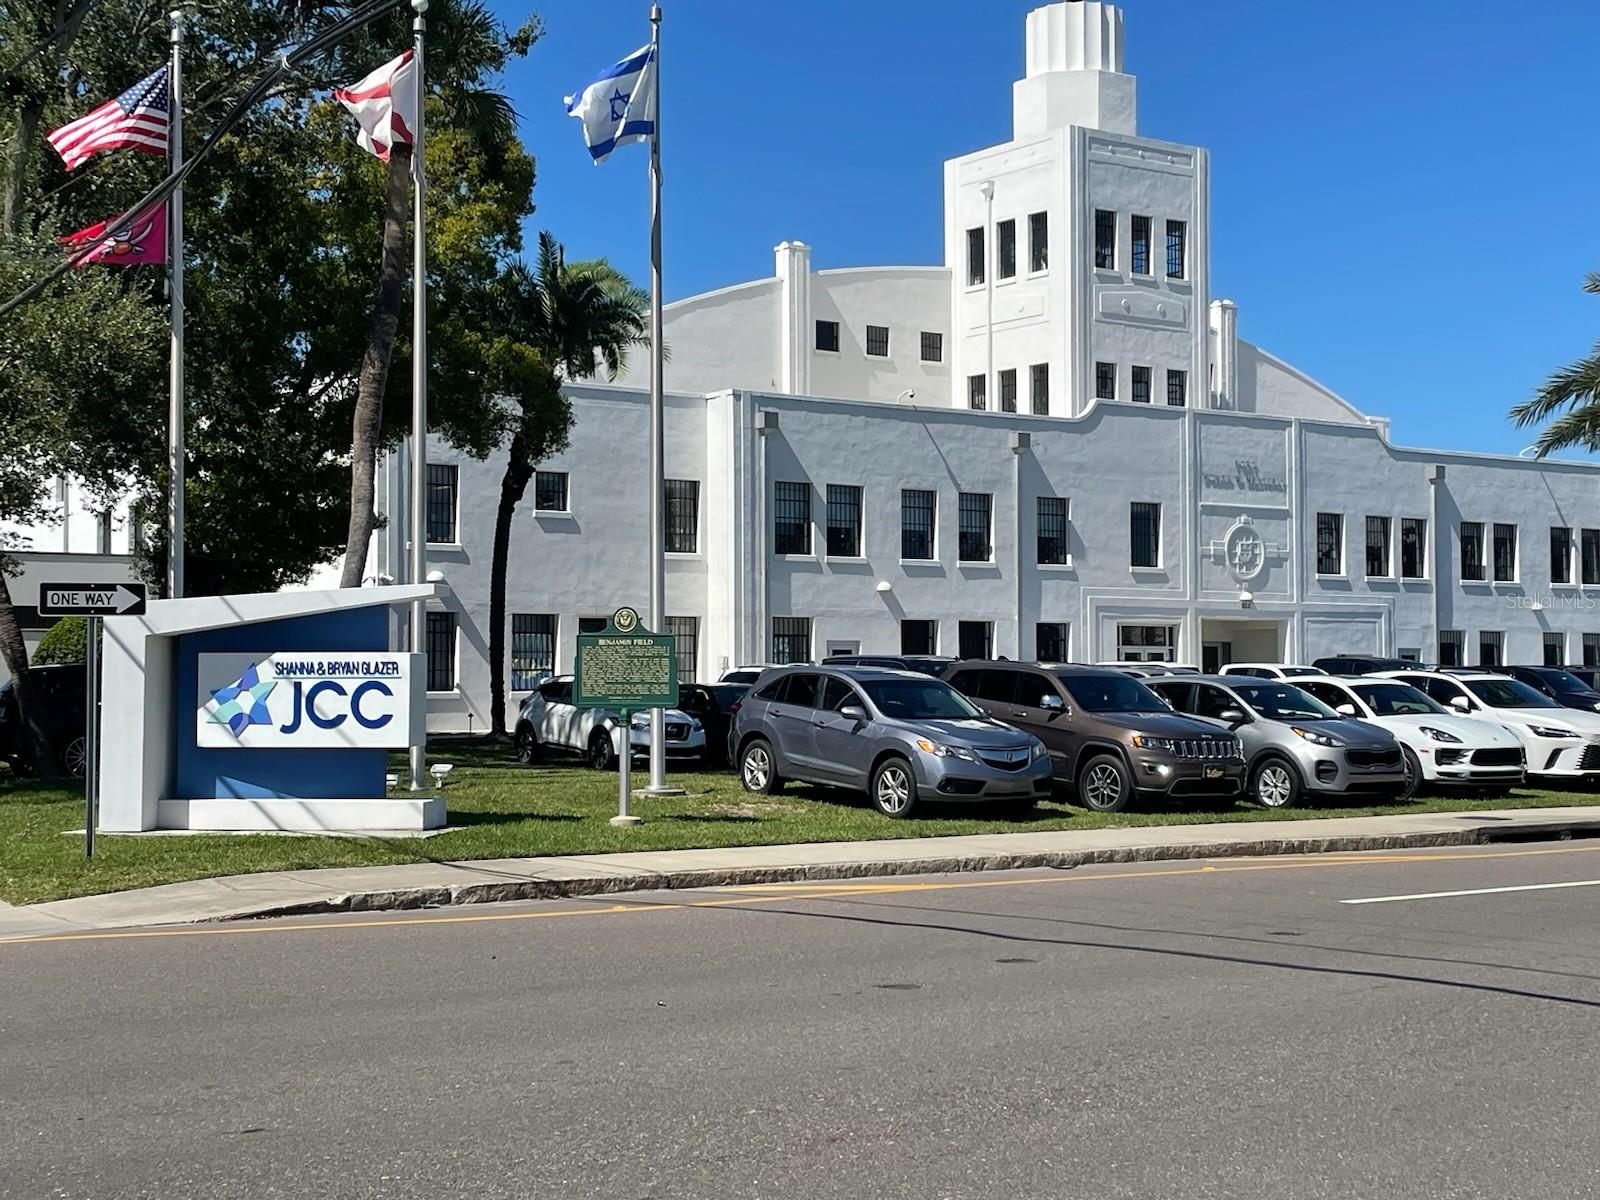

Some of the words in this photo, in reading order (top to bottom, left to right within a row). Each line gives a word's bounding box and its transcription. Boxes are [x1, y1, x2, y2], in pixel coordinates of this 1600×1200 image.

[51, 593, 79, 605] ONE
[85, 593, 114, 605] WAY
[598, 638, 632, 646] BENJAMIN
[633, 638, 654, 646] FIELD
[275, 661, 316, 676] SHANNA
[317, 661, 327, 676] &
[327, 661, 360, 676] BRYAN
[361, 661, 399, 676] GLAZER
[279, 680, 394, 735] JCC
